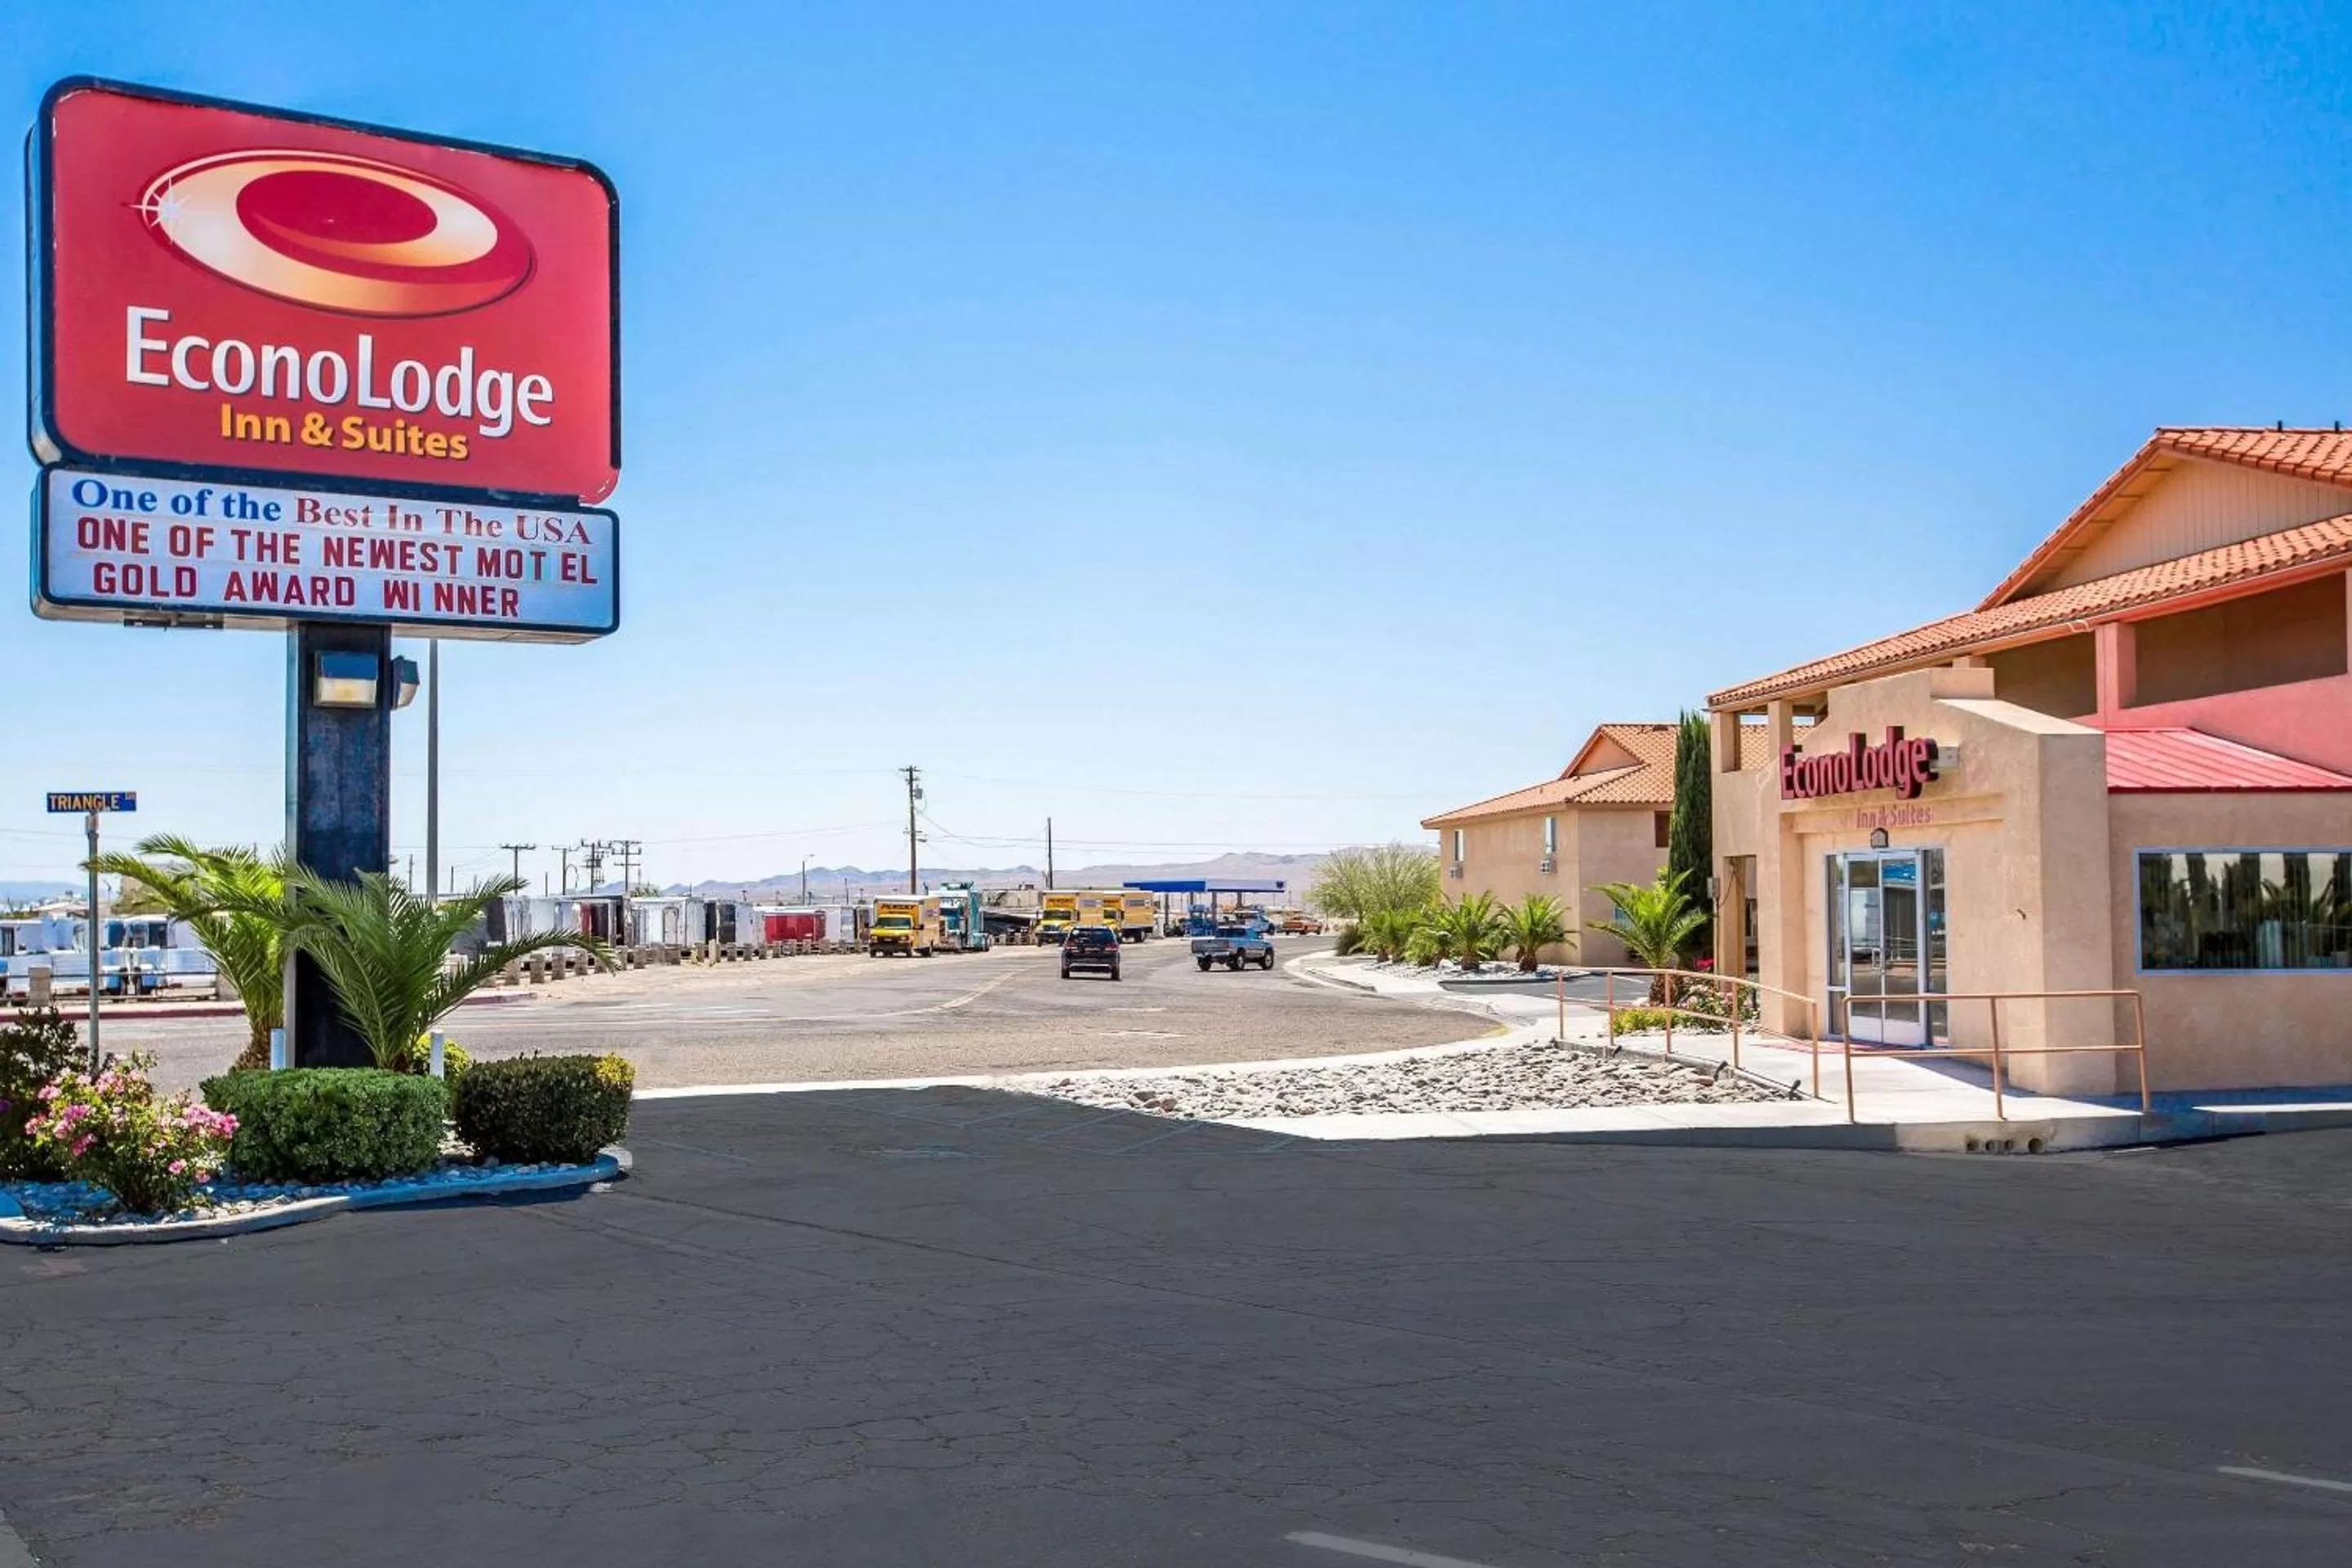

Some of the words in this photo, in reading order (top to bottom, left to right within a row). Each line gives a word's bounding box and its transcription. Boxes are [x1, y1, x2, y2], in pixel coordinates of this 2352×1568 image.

[221, 402, 292, 443] Inn
[301, 411, 334, 447] &
[341, 415, 469, 460] Suites
[71, 479, 158, 513] One
[170, 488, 213, 515] of
[221, 492, 281, 522] the
[296, 497, 373, 528] Best
[387, 504, 423, 532] In
[435, 508, 502, 538] The
[516, 514, 593, 546] USA
[78, 516, 150, 555] ONE
[169, 524, 214, 559] OF
[230, 528, 301, 565] THE
[323, 536, 464, 576] NEWEST
[93, 562, 197, 599] GOLD
[223, 569, 356, 607] AWARD
[49, 794, 121, 811] TRIANGLE
[1855, 808, 1878, 830] Inn
[1890, 802, 1933, 827] Suites
